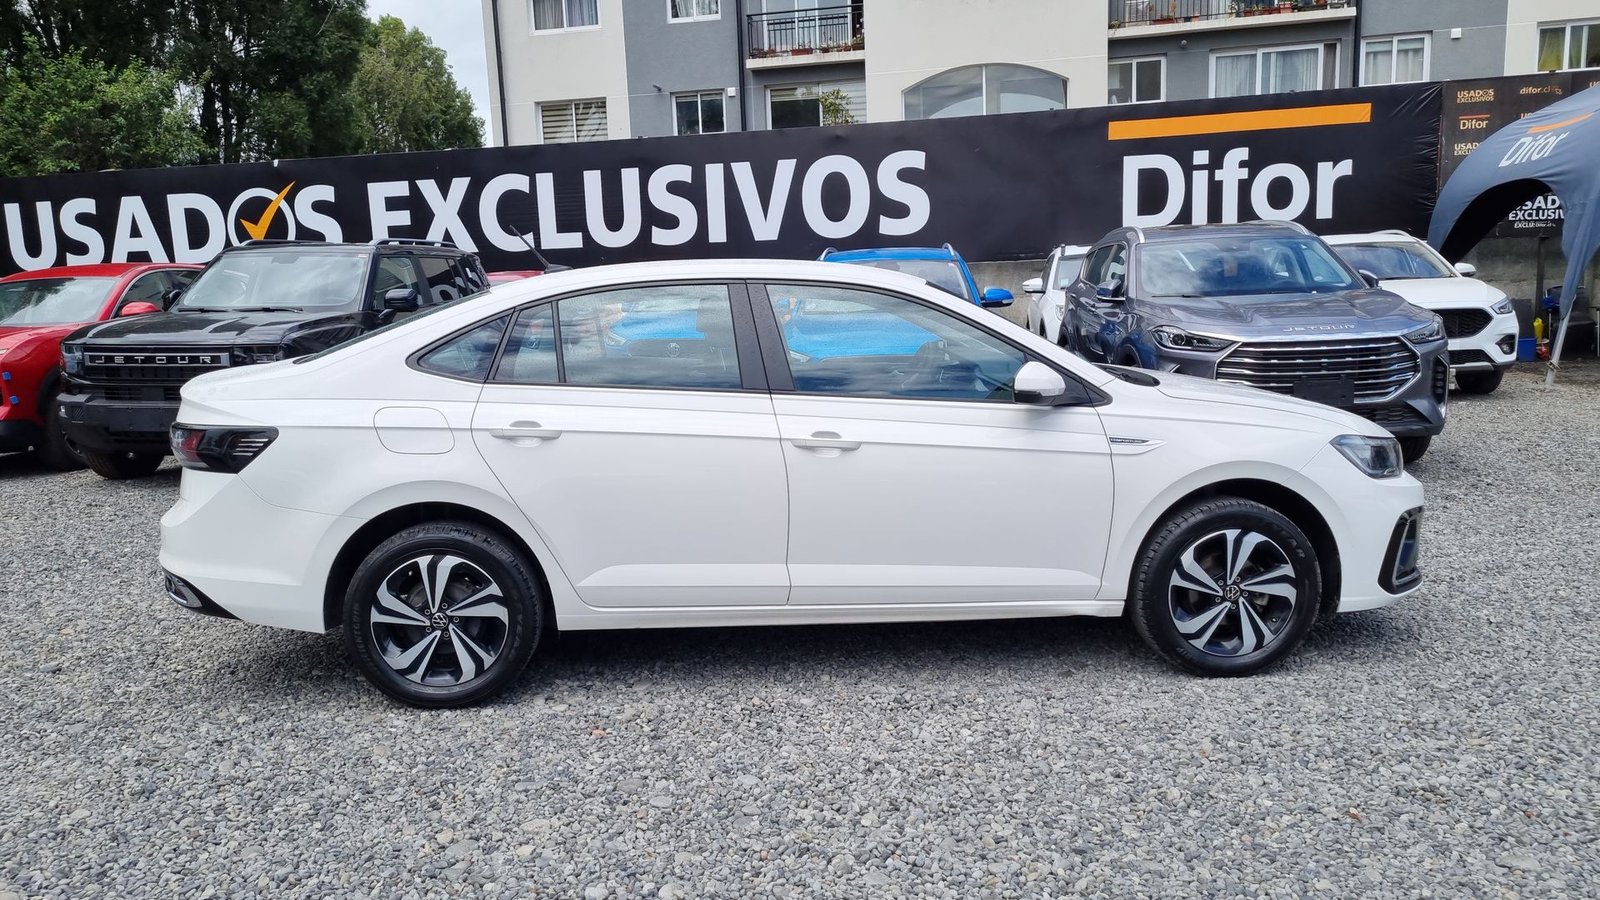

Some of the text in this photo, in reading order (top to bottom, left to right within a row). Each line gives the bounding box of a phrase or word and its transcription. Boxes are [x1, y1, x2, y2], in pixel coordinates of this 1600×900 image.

[1457, 88, 1494, 98] USADOS
[1456, 96, 1494, 104] EXCLUSIVOS
[1460, 119, 1488, 130] Difor
[1454, 142, 1479, 150] USAD
[1498, 131, 1570, 167] Difor
[1122, 147, 1353, 228] Difor
[3, 150, 931, 272] USADOS EXCLUSIVOS
[95, 356, 212, 364] JETOUR
